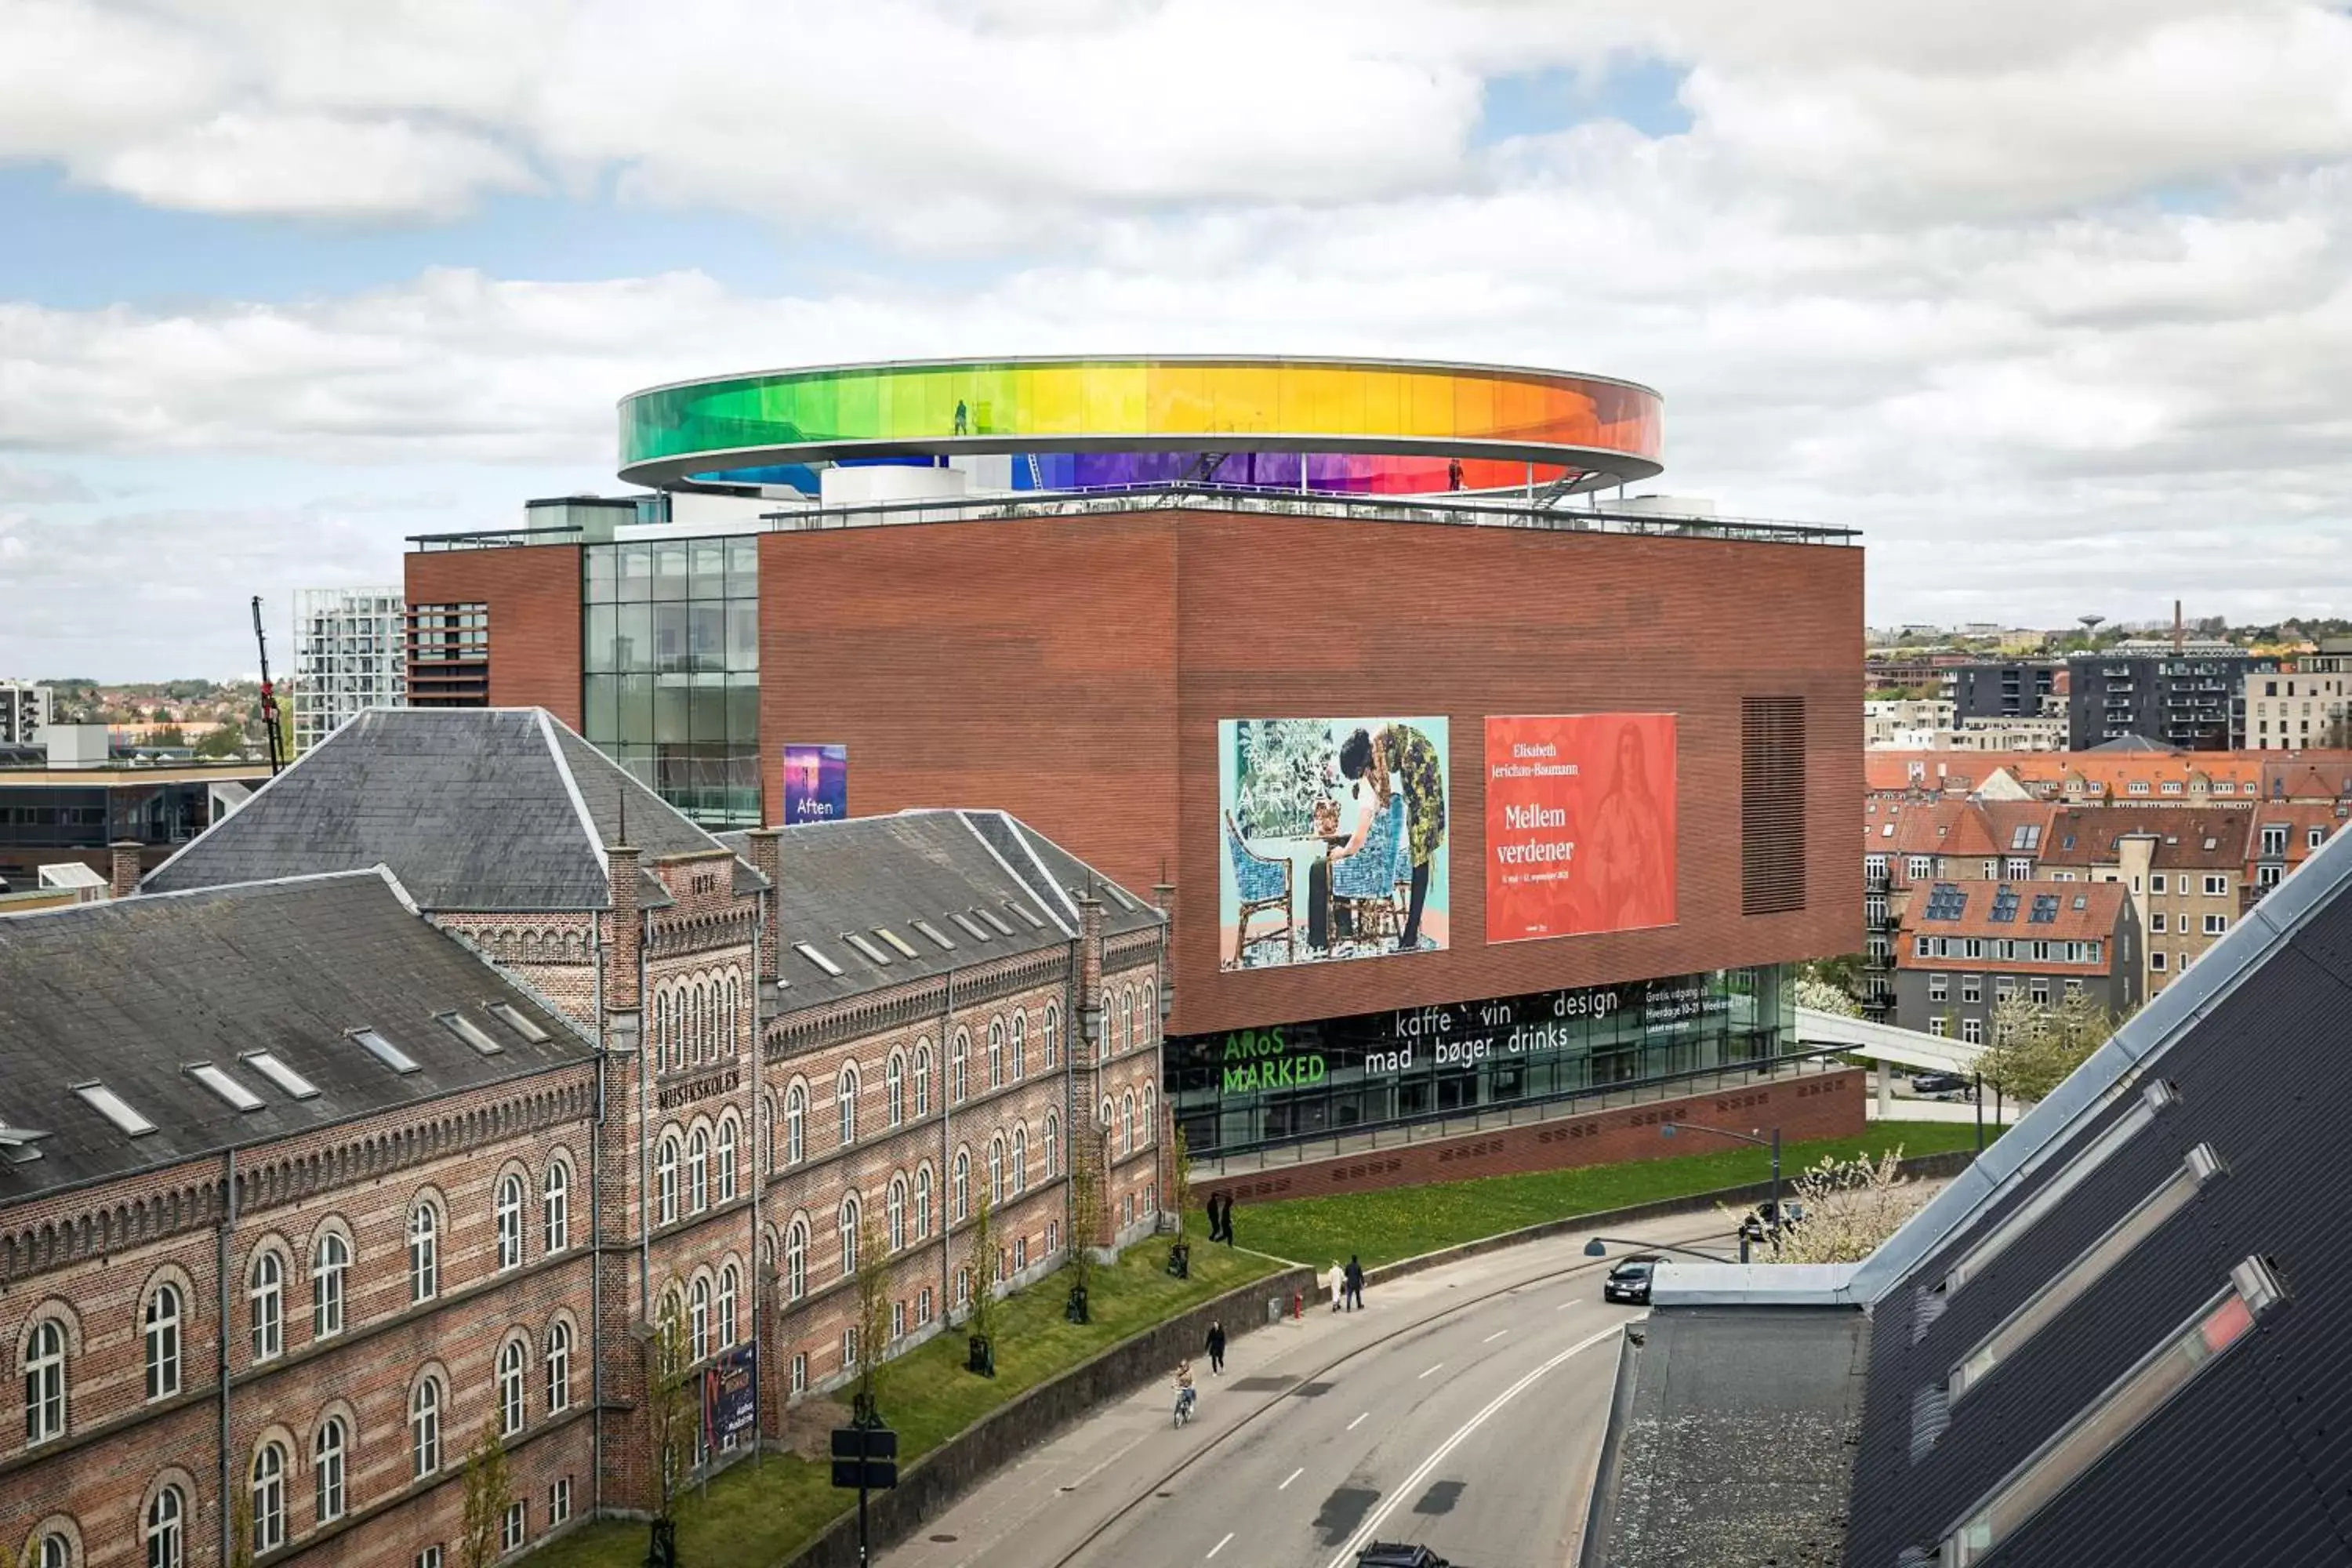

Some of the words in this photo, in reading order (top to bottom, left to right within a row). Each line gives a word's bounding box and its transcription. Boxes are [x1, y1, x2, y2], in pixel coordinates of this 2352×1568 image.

[1513, 743, 1557, 758] Elisabeth
[797, 797, 834, 815] Aften
[1504, 803, 1566, 830] Mellem
[1497, 837, 1575, 865] verdener
[1396, 1006, 1452, 1038] kaffe
[1480, 1000, 1512, 1026] vin
[1553, 988, 1618, 1020] design
[1224, 1026, 1285, 1061] ARoS
[1365, 1040, 1413, 1074] mad
[1435, 1036, 1494, 1069] bøger
[1508, 1021, 1568, 1054] drinks
[659, 1069, 739, 1112] MUSIKSKOLEN
[1223, 1054, 1325, 1094] MARKED
